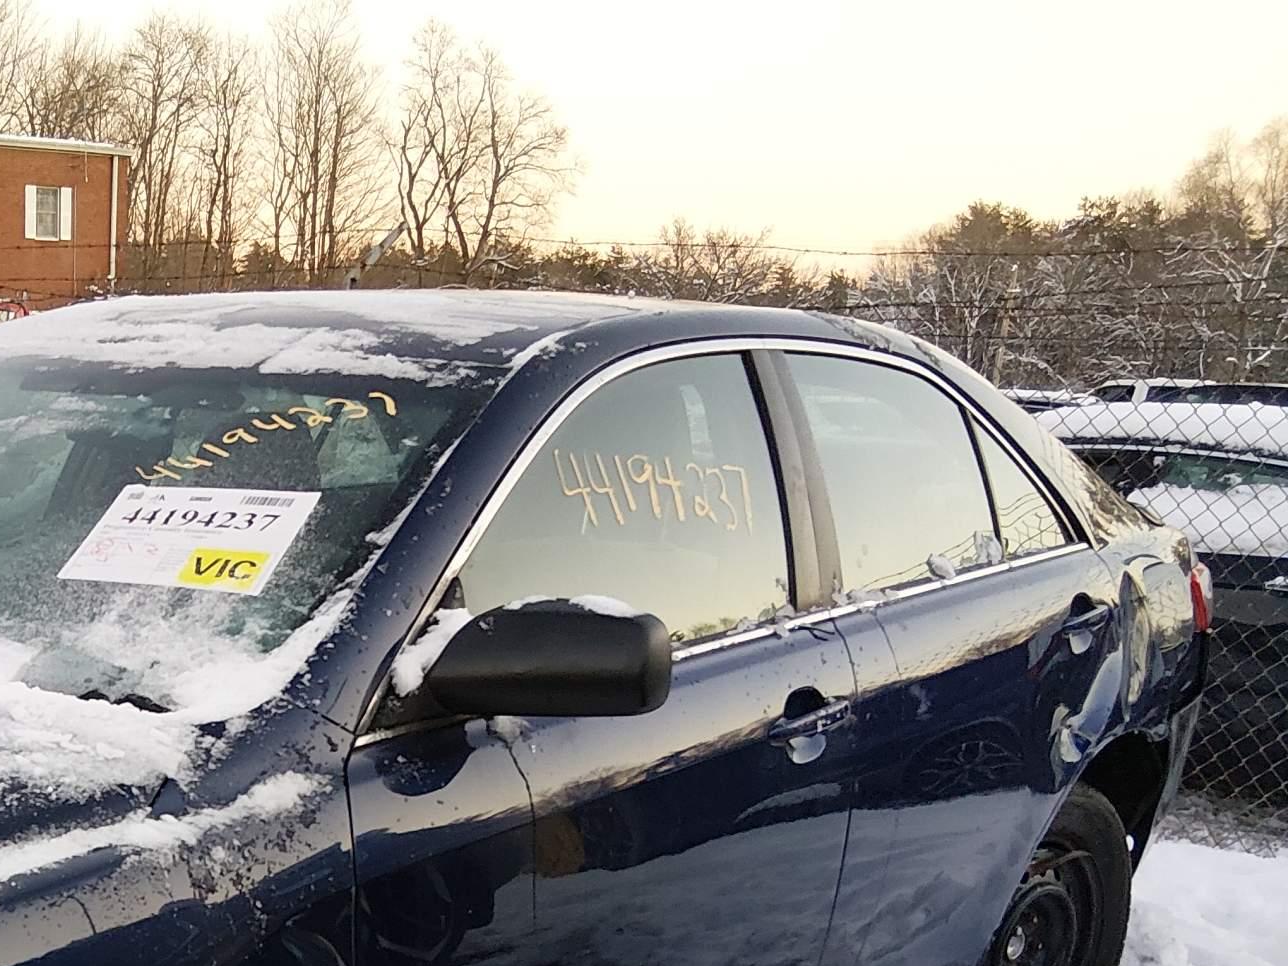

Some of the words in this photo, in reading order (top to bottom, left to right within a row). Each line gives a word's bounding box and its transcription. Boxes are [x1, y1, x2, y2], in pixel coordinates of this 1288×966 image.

[135, 391, 397, 480] 44194237
[122, 507, 281, 532] 44194237
[554, 449, 752, 536] 44194237
[193, 556, 257, 581] VIC
